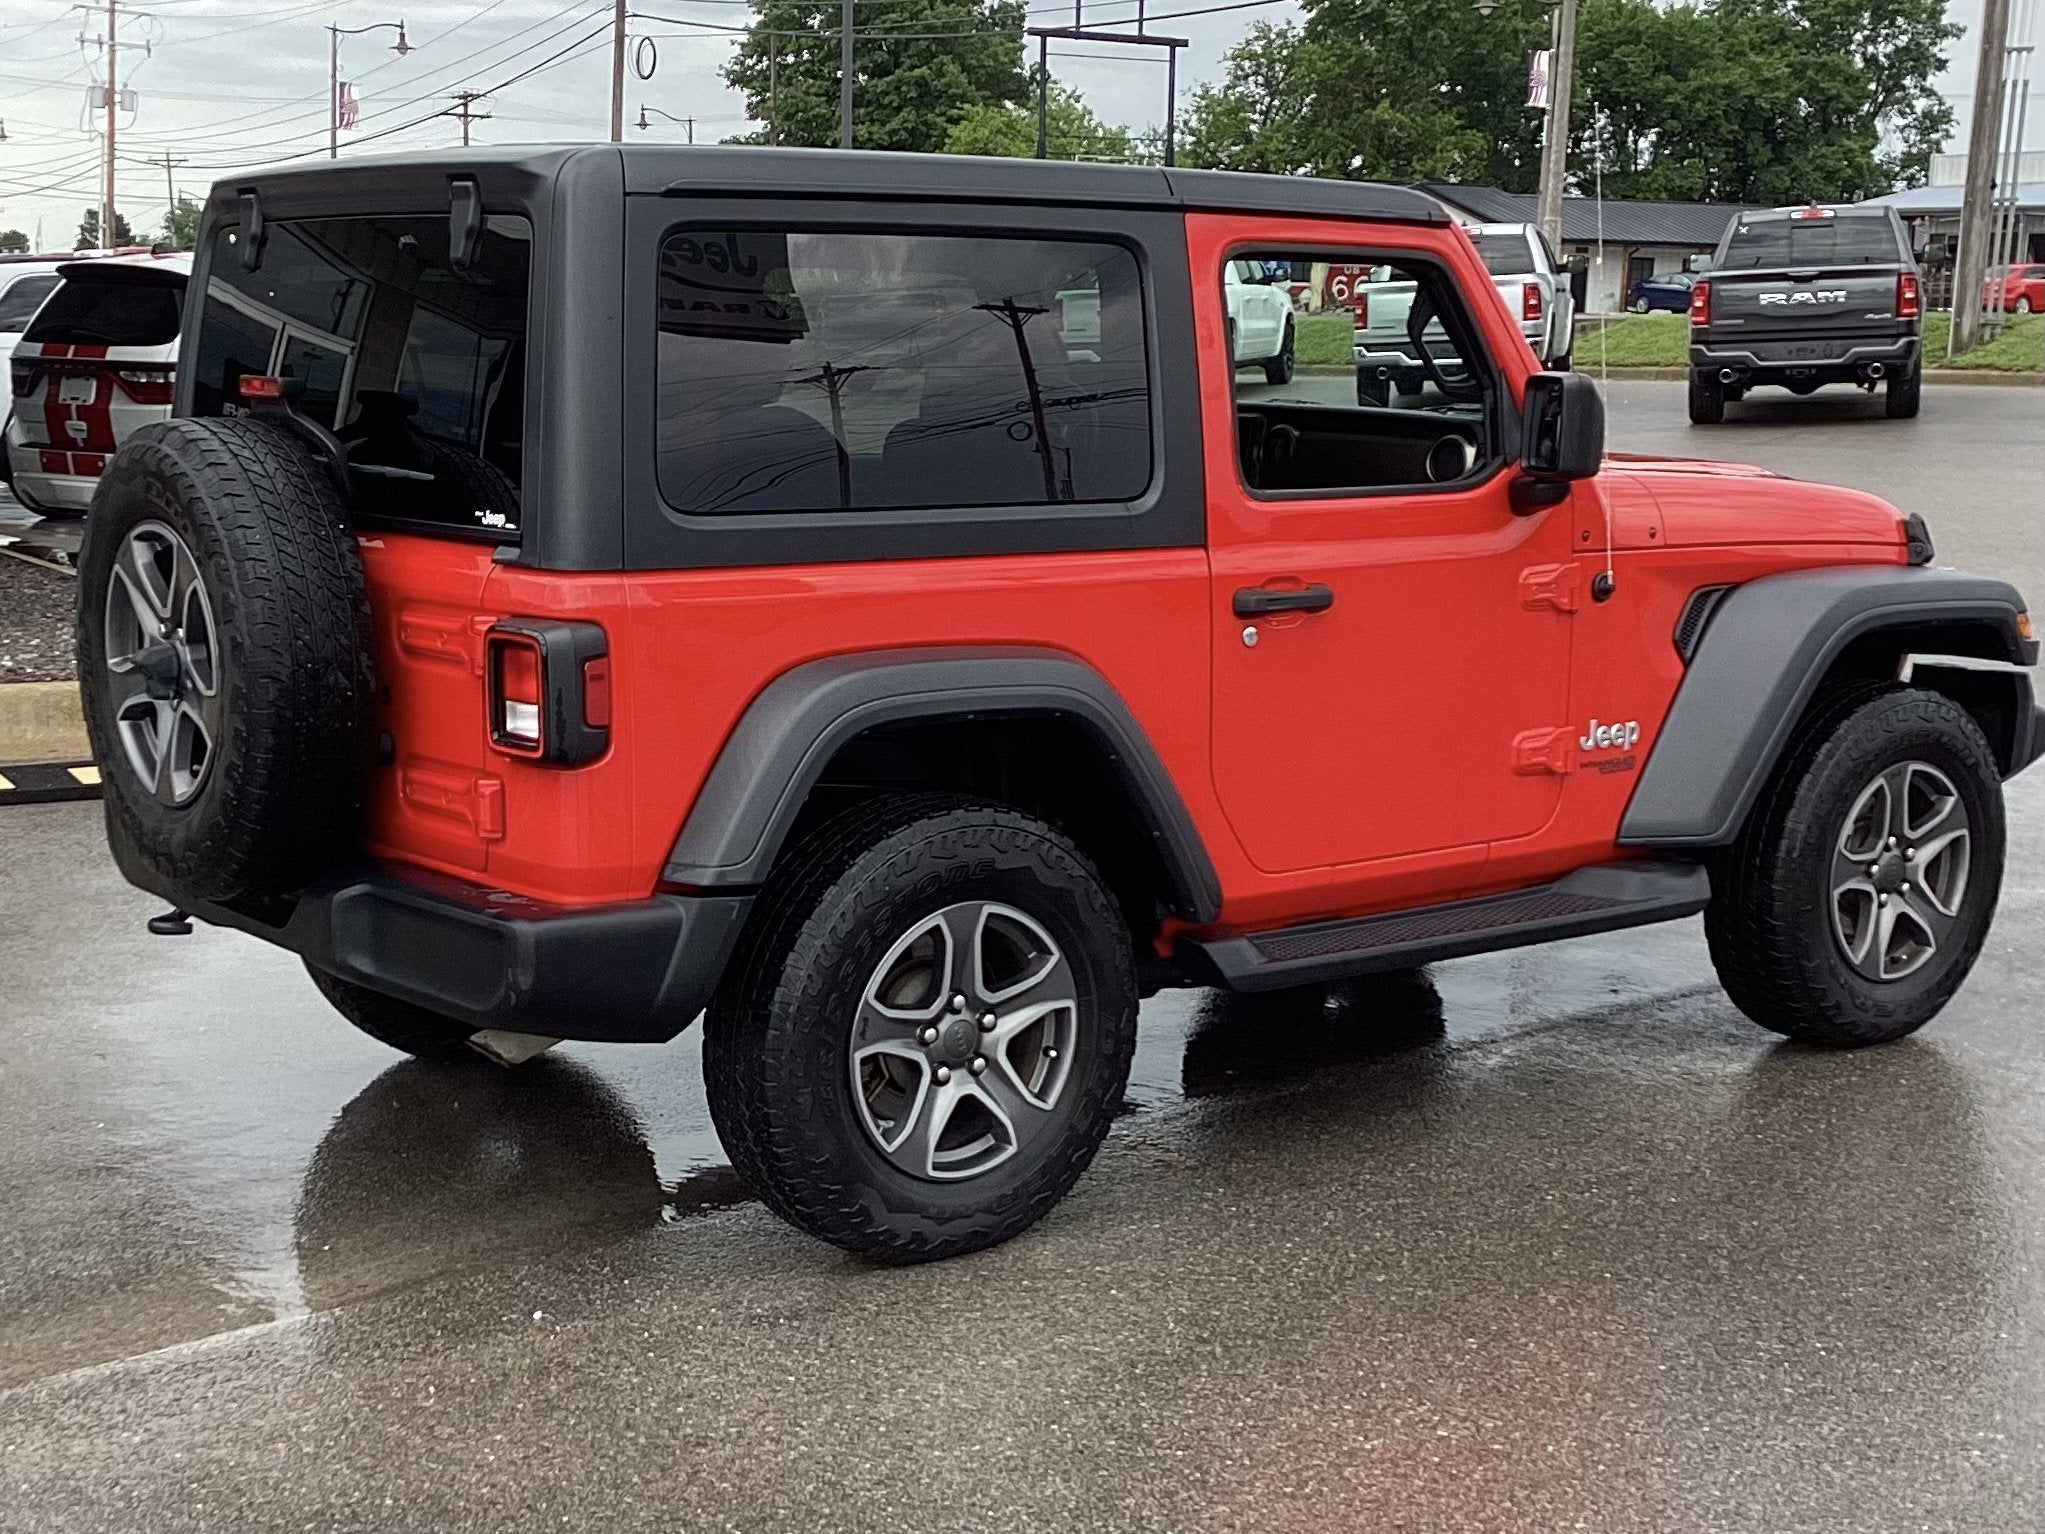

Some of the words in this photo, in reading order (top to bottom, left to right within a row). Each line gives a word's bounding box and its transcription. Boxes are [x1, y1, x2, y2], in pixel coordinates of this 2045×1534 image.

[1759, 289, 1847, 305] RAM
[482, 509, 506, 528] Jeep
[1579, 718, 1641, 752] Jeep
